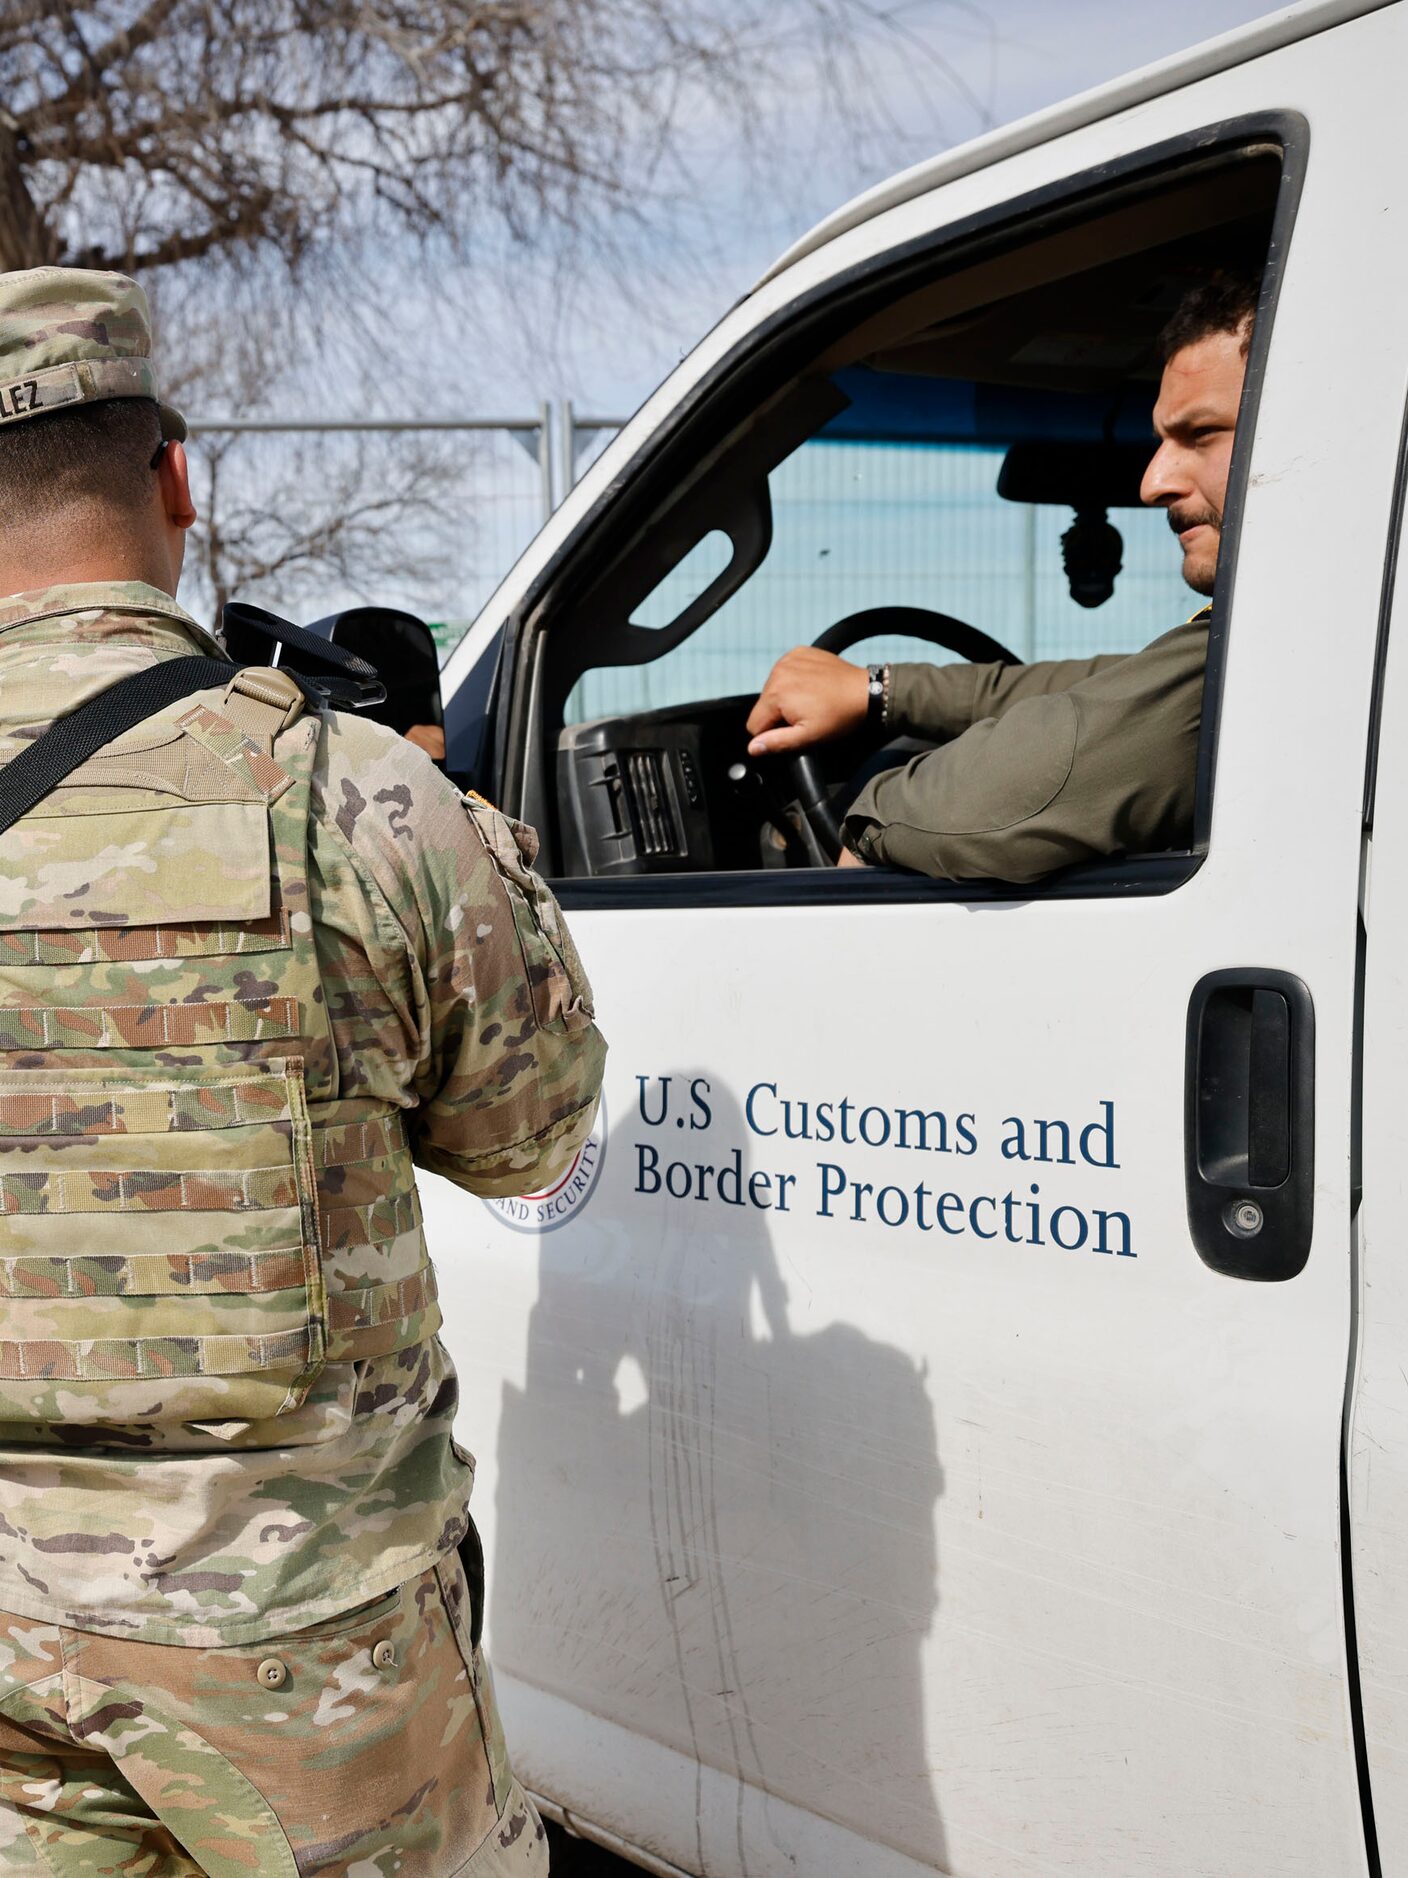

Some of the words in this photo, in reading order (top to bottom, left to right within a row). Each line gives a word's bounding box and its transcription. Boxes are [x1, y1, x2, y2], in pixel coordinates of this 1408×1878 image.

[635, 1075, 713, 1131] U.S
[745, 1082, 978, 1156] Customs
[1000, 1100, 1122, 1170] and
[494, 1198, 530, 1221] AND
[536, 1138, 598, 1223] SECURITY
[634, 1143, 797, 1212] Border
[816, 1162, 1138, 1258] Protection
